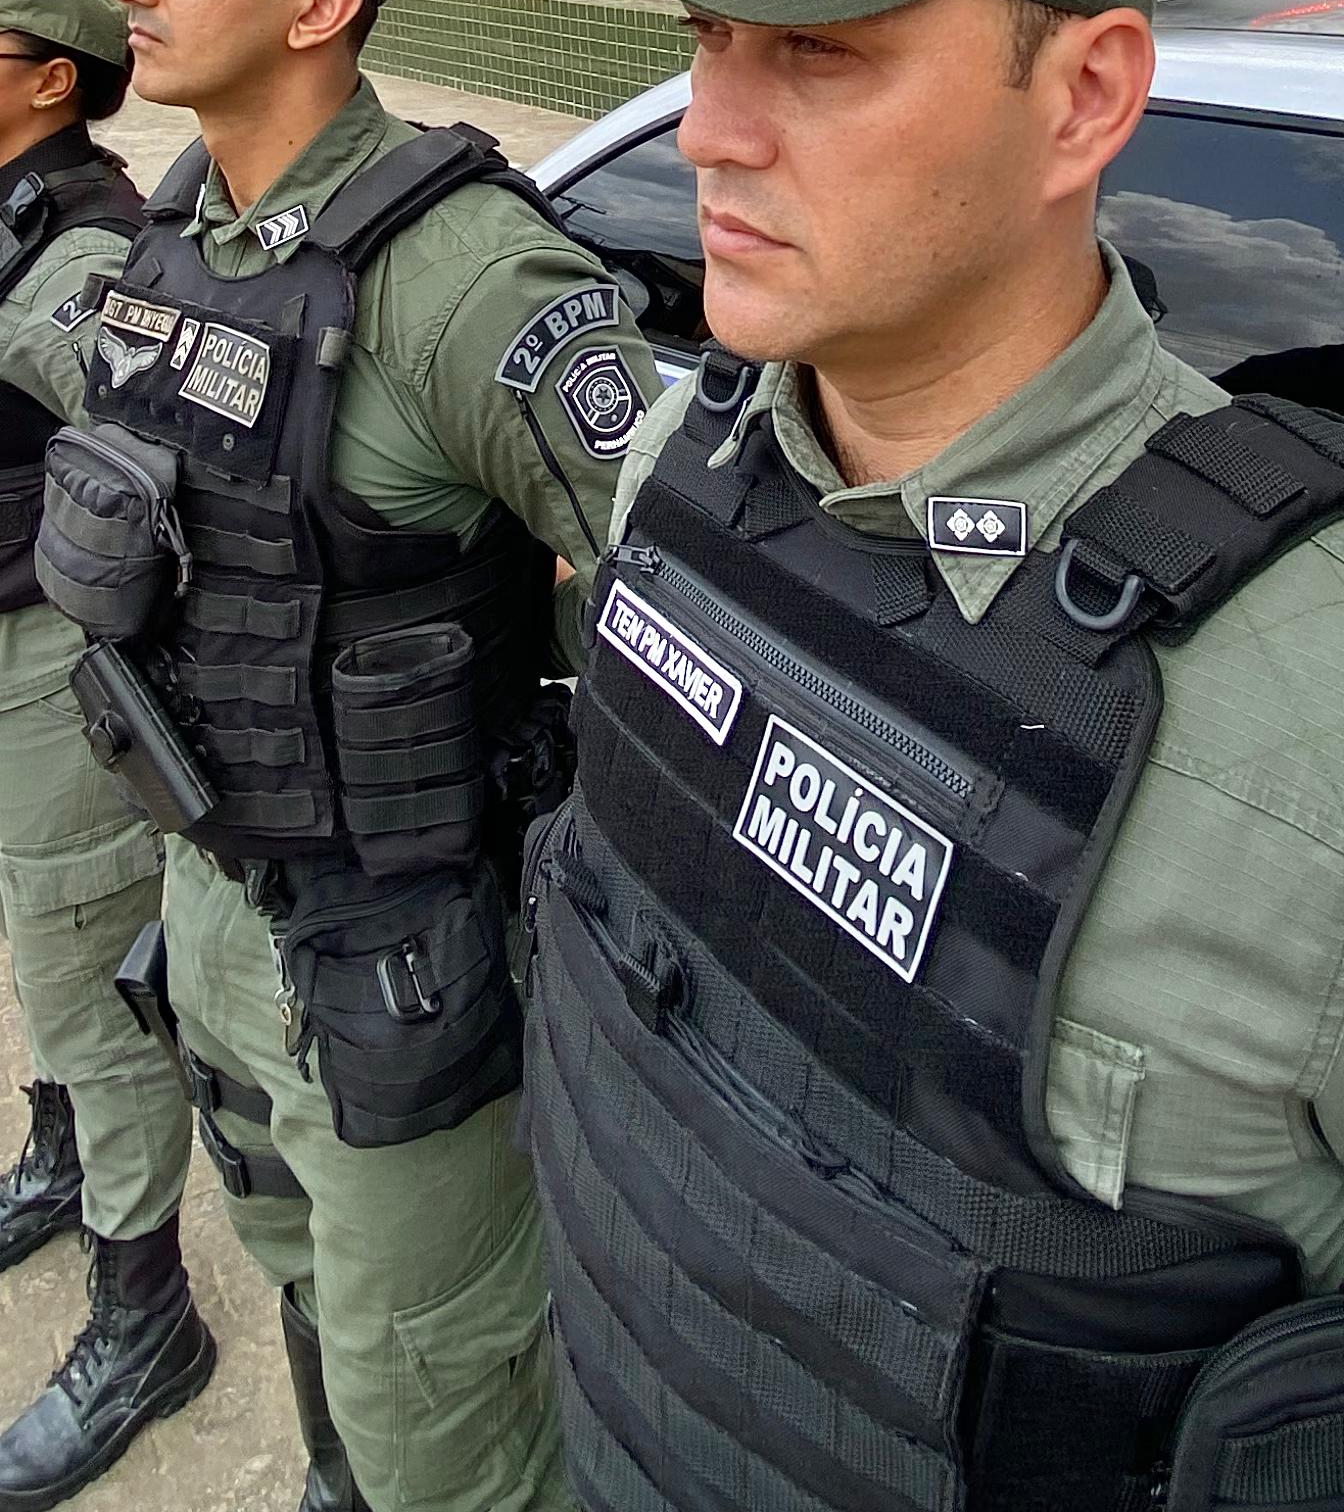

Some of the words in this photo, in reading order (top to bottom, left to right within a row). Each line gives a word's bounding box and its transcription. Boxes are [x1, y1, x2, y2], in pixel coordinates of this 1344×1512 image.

[544, 292, 607, 339] BPM
[188, 365, 260, 417] MILITAR
[202, 334, 266, 385] POLÍCIA
[611, 598, 645, 647] TEN
[638, 625, 668, 667] PM
[661, 644, 724, 719] XAVIER
[764, 741, 926, 901] POLÍCIA
[748, 794, 914, 960] MILITAR
